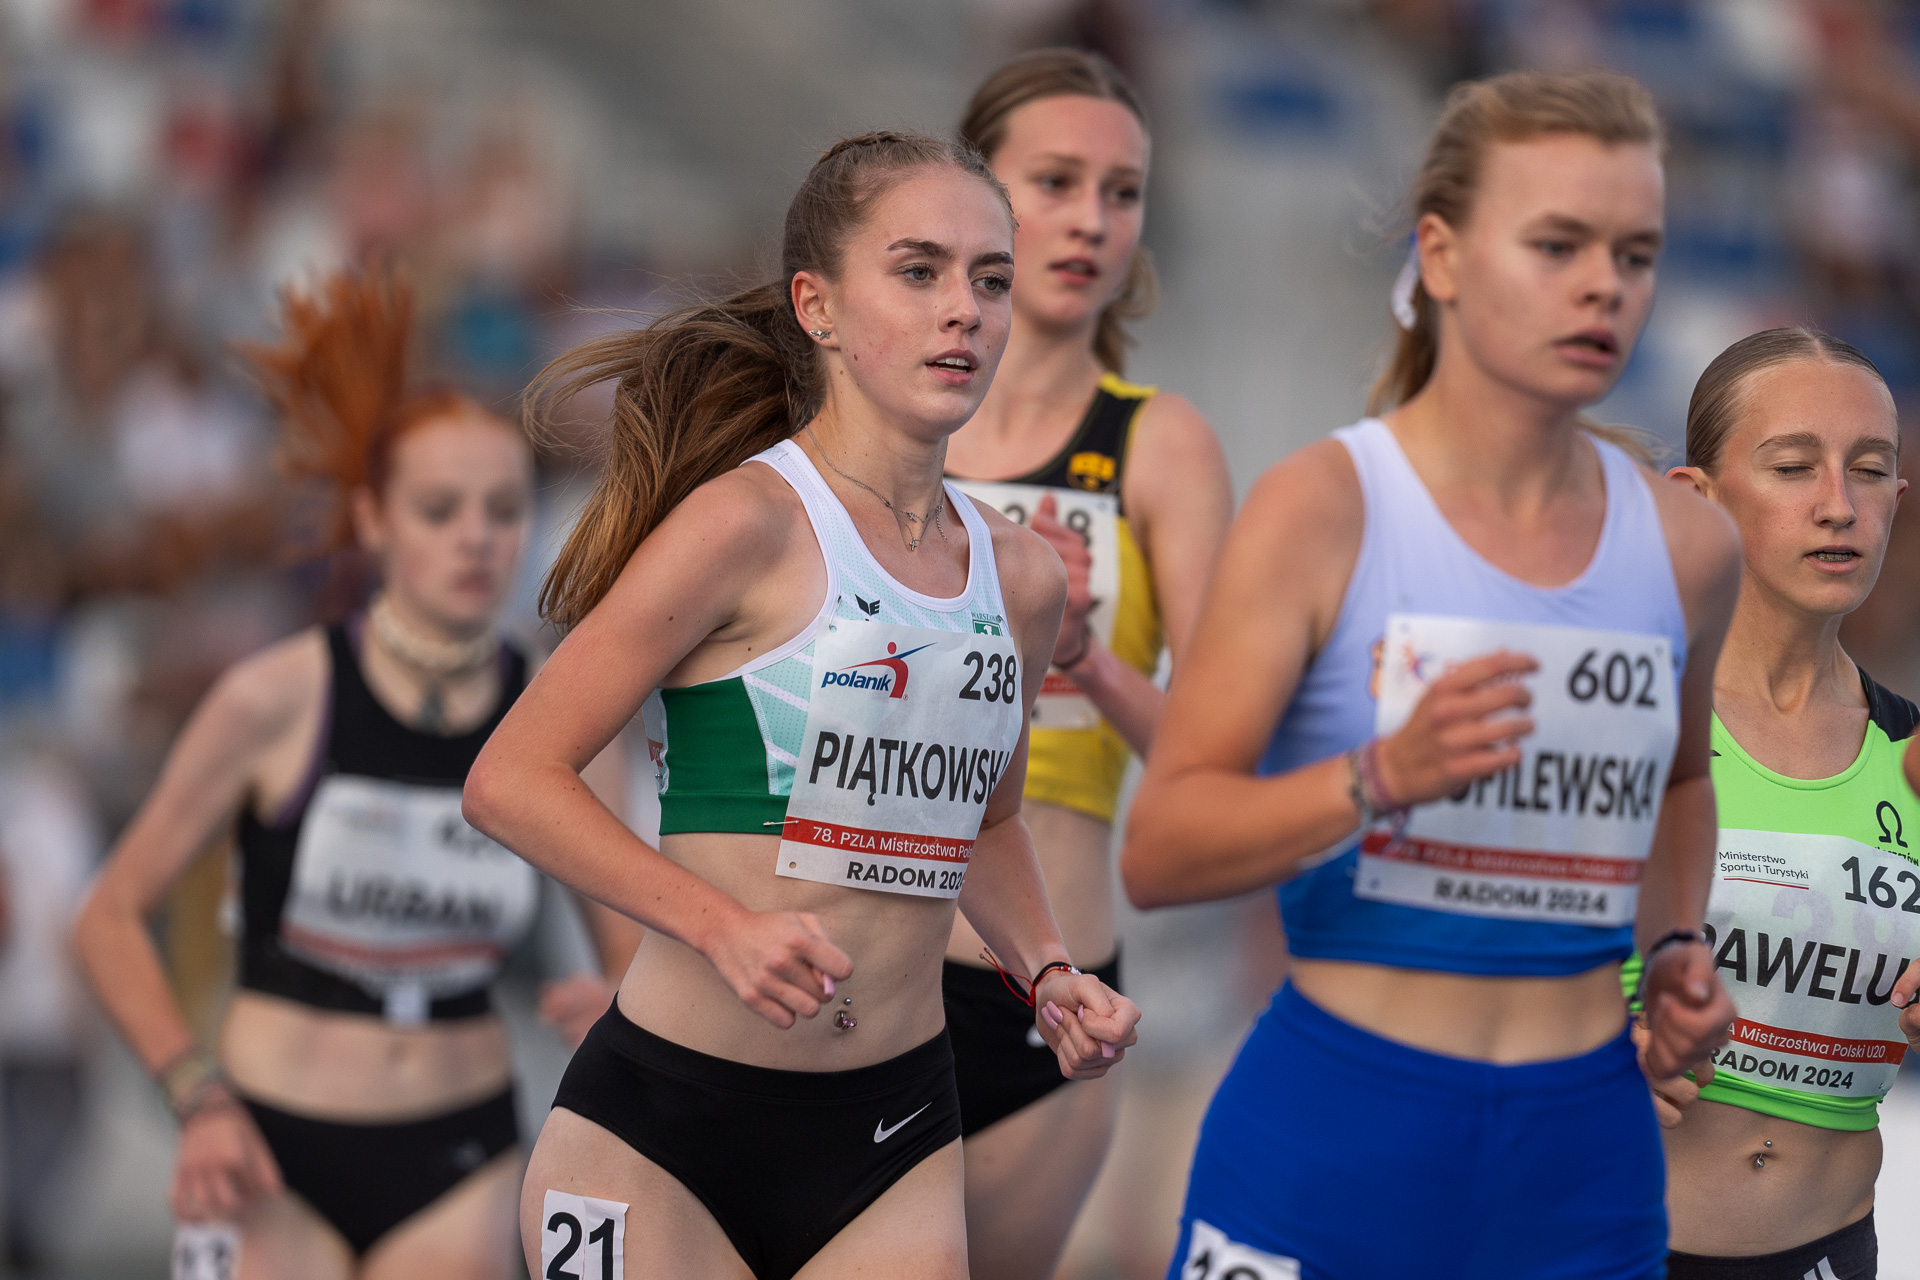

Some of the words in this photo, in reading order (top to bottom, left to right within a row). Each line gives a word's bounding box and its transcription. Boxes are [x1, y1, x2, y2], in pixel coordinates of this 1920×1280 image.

[820, 670, 892, 691] polanik
[959, 651, 1017, 704] 238
[1566, 648, 1657, 708] 602
[808, 730, 1010, 806] PIĄTKOWSK
[812, 826, 835, 844] 78.
[840, 831, 876, 849] PZLA
[880, 837, 956, 858] Mistrzostwa
[1719, 851, 1786, 865] Ministerstwo
[846, 861, 936, 889] RADOM
[1720, 863, 1756, 873] Sportu
[1758, 864, 1762, 873] i
[1763, 865, 1809, 880] Turystyki
[1435, 876, 1540, 908] RADOM
[1546, 886, 1608, 914] 2024
[1740, 1025, 1829, 1055] Mistrzostwa
[1831, 1043, 1866, 1058] Polski
[1866, 1045, 1886, 1058] U20
[1711, 1048, 1799, 1082] RADOM
[1802, 1065, 1855, 1089] 2024
[546, 1211, 615, 1280] 21
